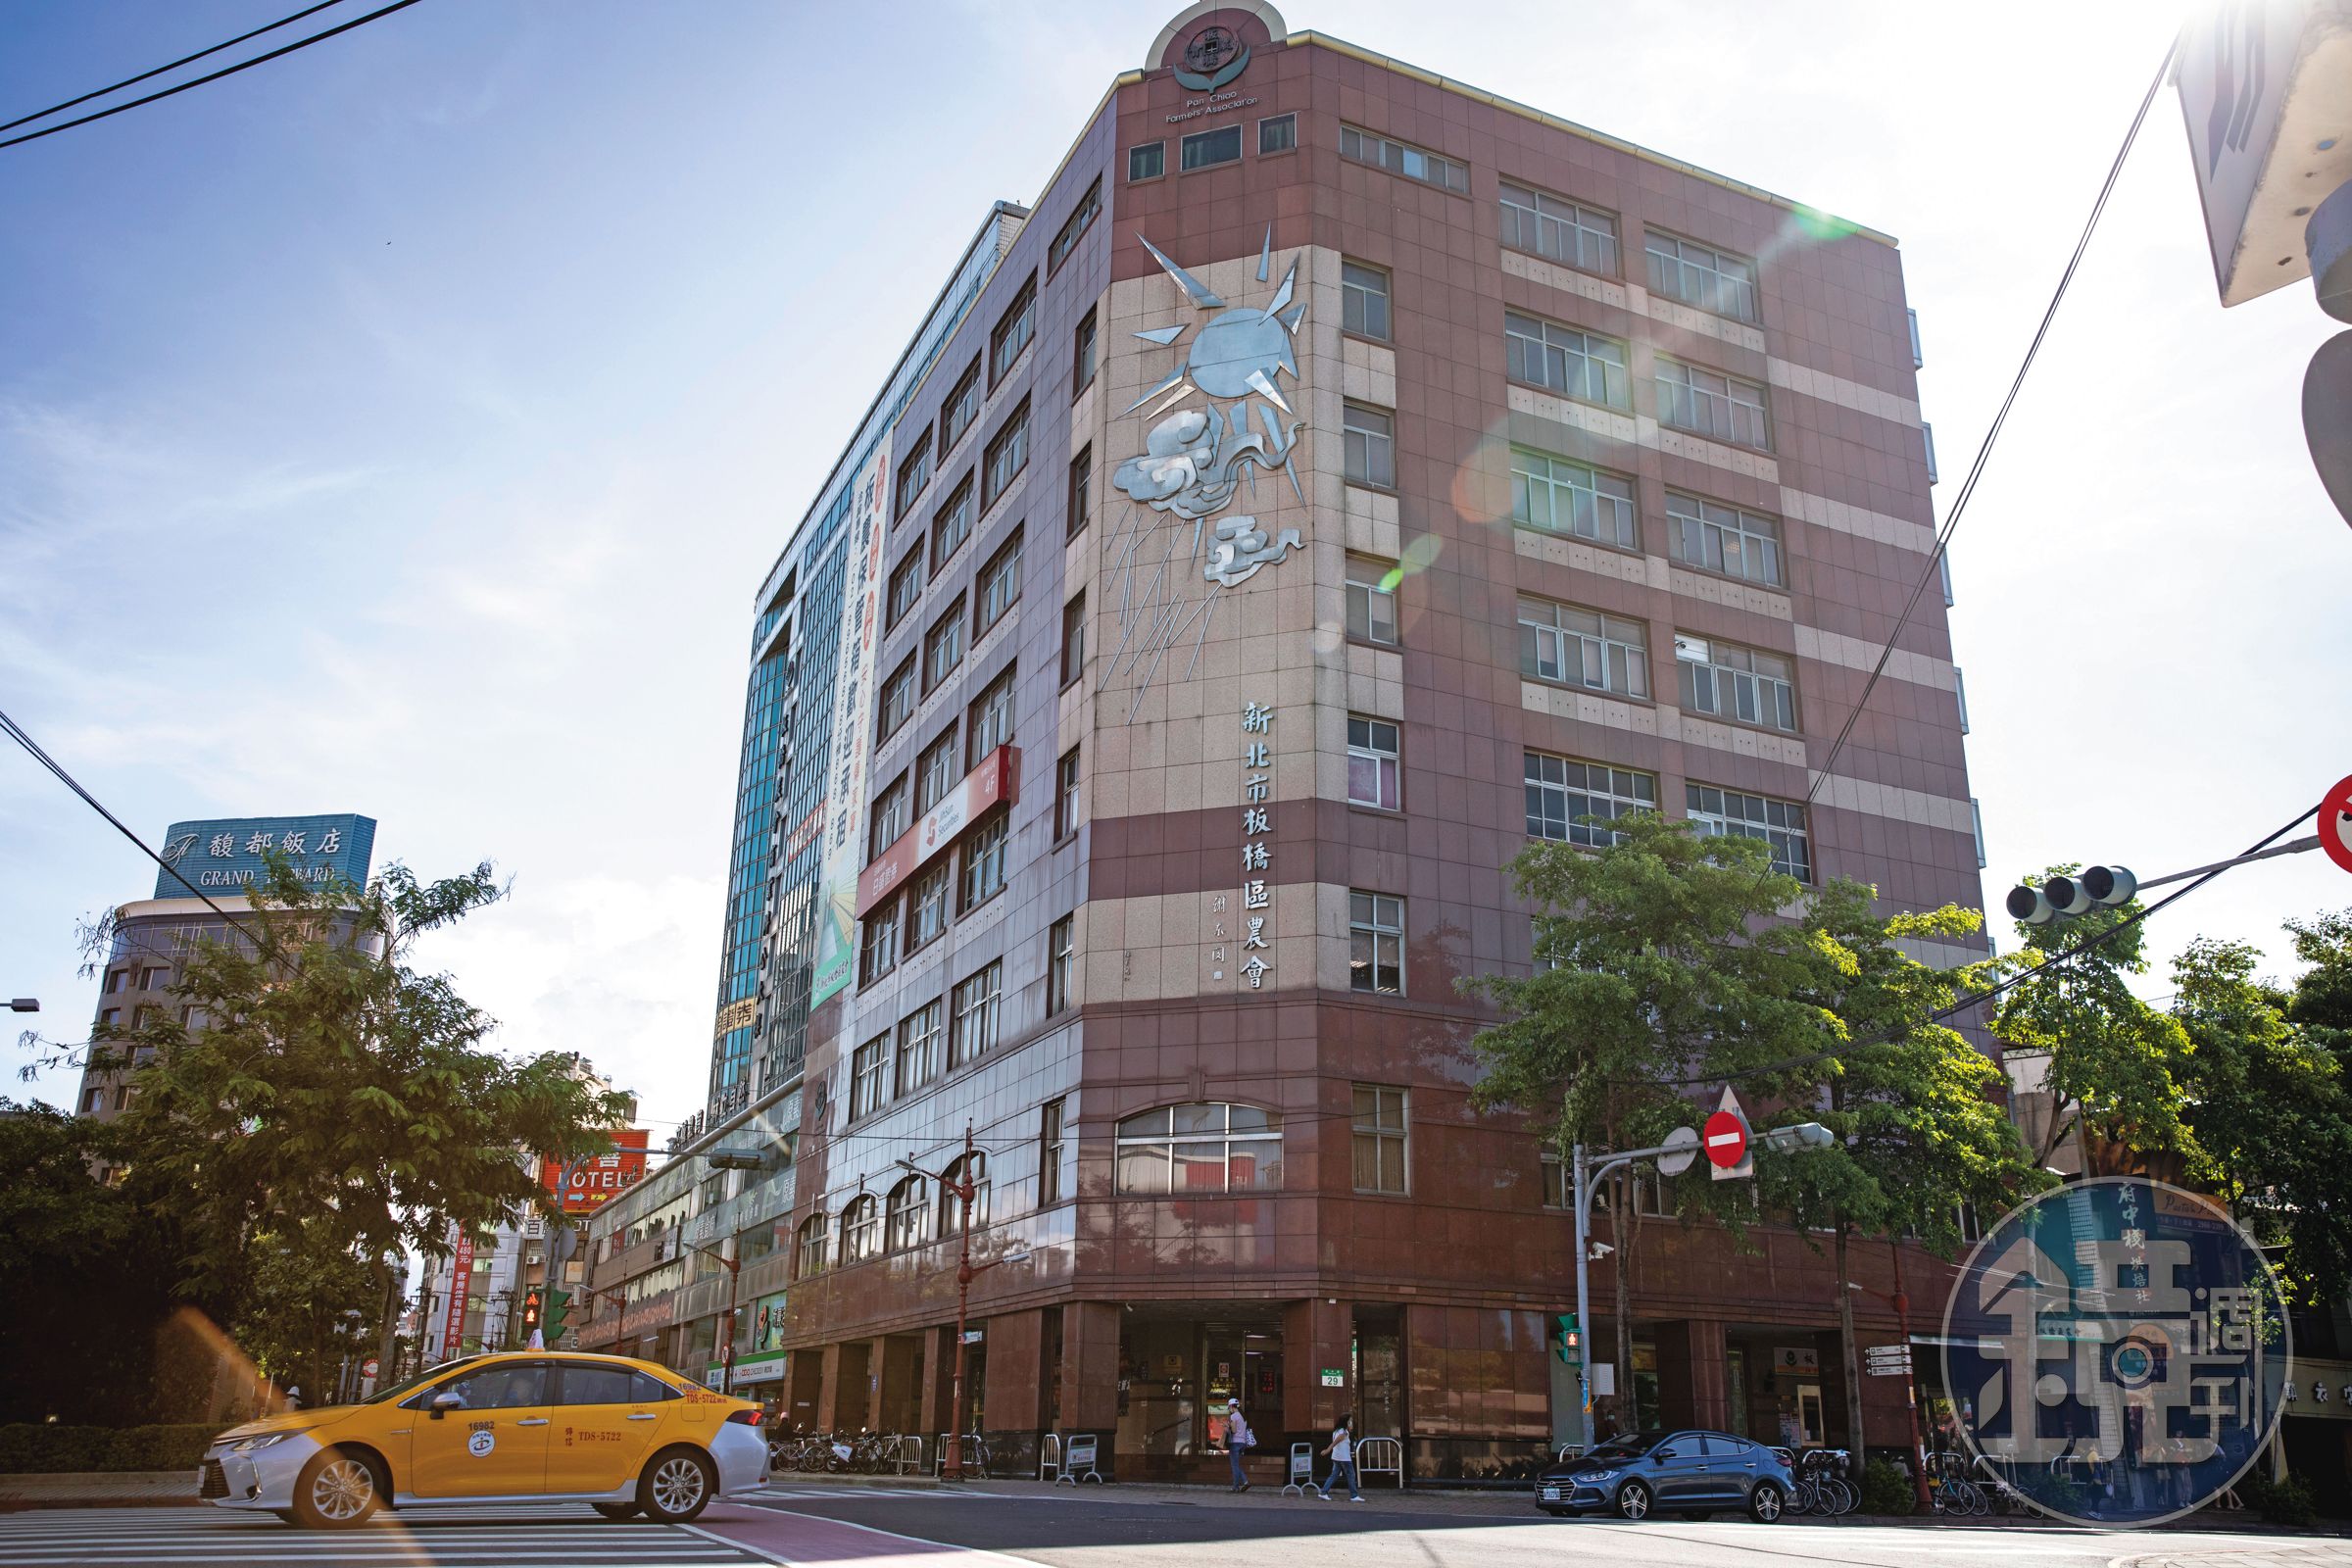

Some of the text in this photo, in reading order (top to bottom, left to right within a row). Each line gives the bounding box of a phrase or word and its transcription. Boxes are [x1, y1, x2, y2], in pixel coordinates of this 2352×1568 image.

[1187, 90, 1237, 108] Pan Chiao
[1205, 96, 1257, 114] Association
[208, 828, 342, 858] 馥都飯店
[1240, 701, 1274, 990] 新北市板橋區農會
[200, 869, 255, 886] GRAND
[1327, 1376, 1339, 1386] 29
[686, 1394, 717, 1404] TDS-5722
[467, 1420, 495, 1431] 16982
[578, 1431, 621, 1443] TDS-5722
